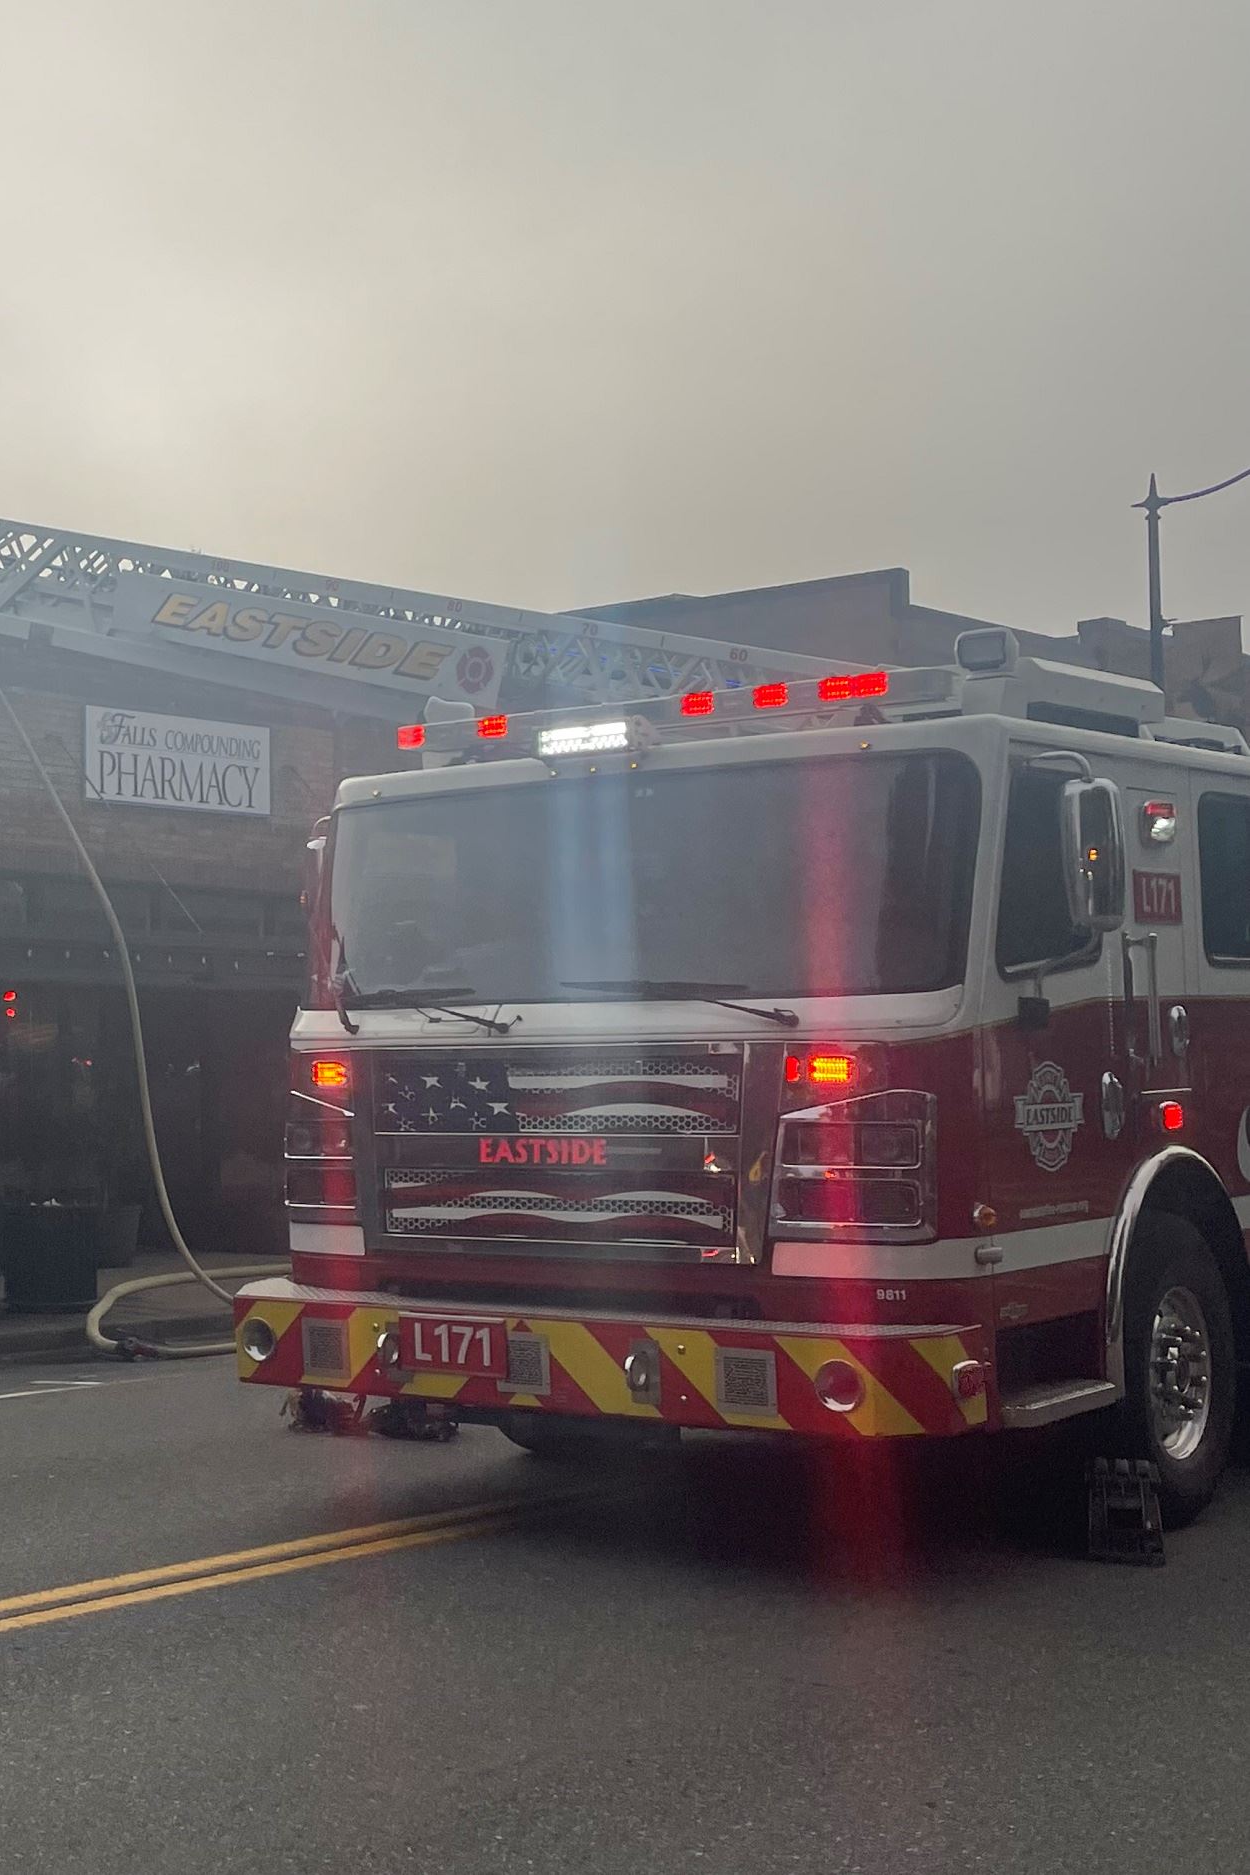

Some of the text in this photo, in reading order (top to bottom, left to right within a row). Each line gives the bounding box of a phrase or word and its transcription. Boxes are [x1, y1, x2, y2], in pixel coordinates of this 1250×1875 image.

[325, 580, 340, 592] 90
[446, 600, 463, 613] 80
[151, 592, 455, 681] EASTSIDE
[582, 622, 599, 636] 70
[729, 648, 749, 662] 60
[164, 729, 261, 760] COMPOUNDING
[98, 750, 261, 808] PHARMACY
[1142, 877, 1176, 914] L171
[1026, 1106, 1074, 1126] EASTSIDE
[479, 1137, 607, 1166] EASTSIDE
[876, 1288, 906, 1301] 9811
[413, 1322, 491, 1367] L171
